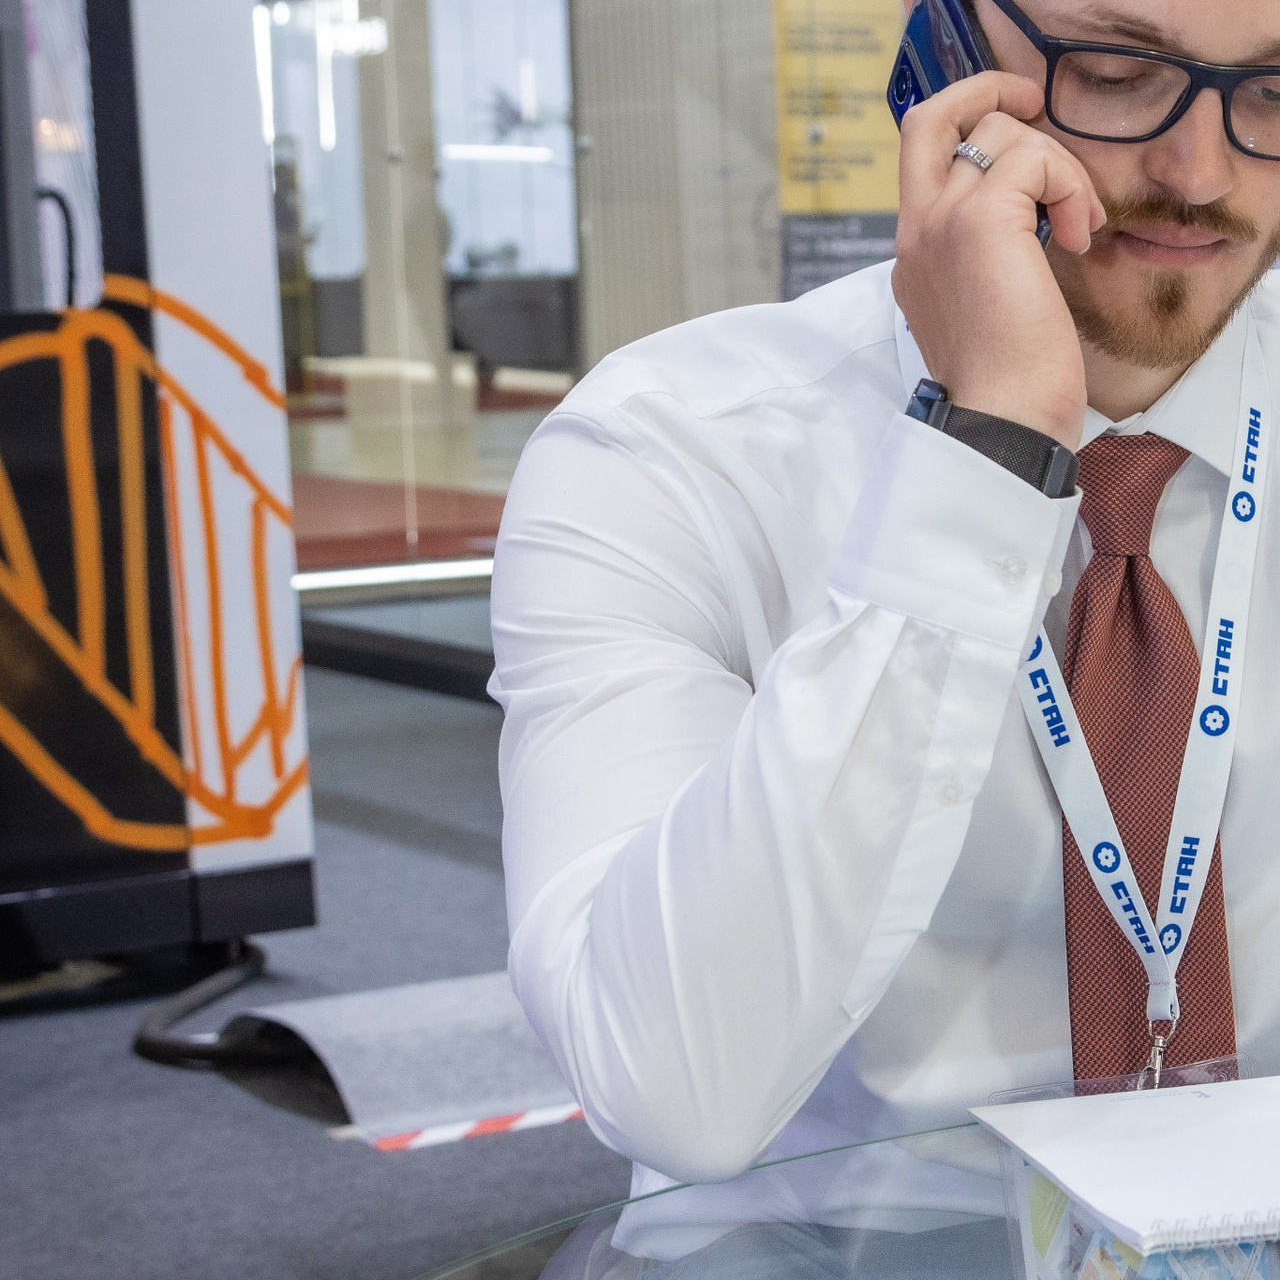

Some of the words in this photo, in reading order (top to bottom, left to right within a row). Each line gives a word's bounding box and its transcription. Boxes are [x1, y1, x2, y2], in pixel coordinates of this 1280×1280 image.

[1243, 408, 1261, 484] СТАН
[1212, 618, 1235, 697] СТАН
[1028, 669, 1070, 747] СТАН
[1170, 836, 1200, 915] СТАН
[1110, 880, 1155, 955] СТАН
